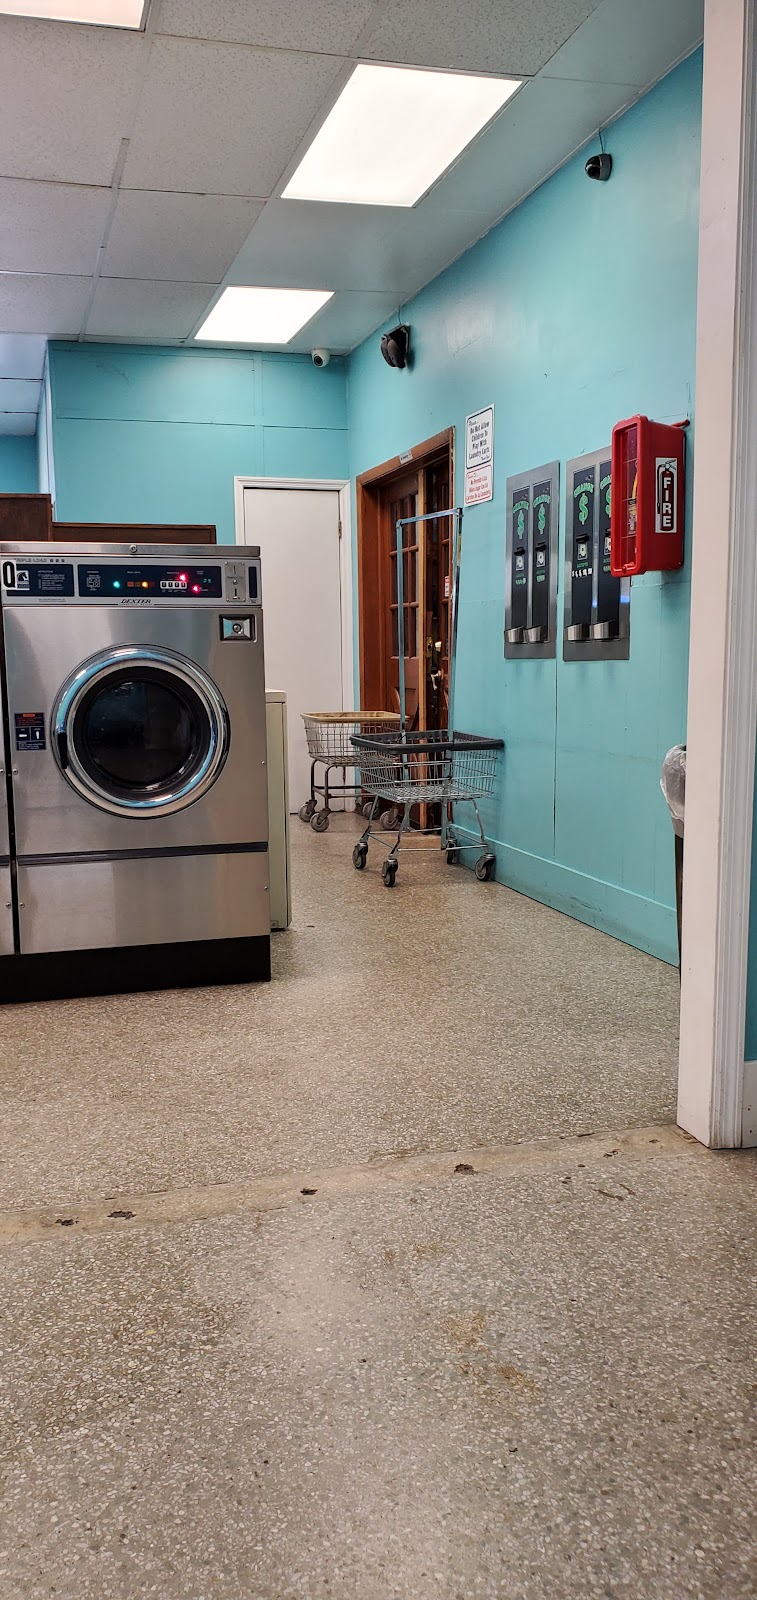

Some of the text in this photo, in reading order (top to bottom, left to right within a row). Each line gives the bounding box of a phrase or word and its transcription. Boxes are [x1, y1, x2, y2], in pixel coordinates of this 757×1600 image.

[472, 432, 484, 442] Children
[469, 450, 481, 459] Laundry
[663, 477, 672, 527] FIRE
